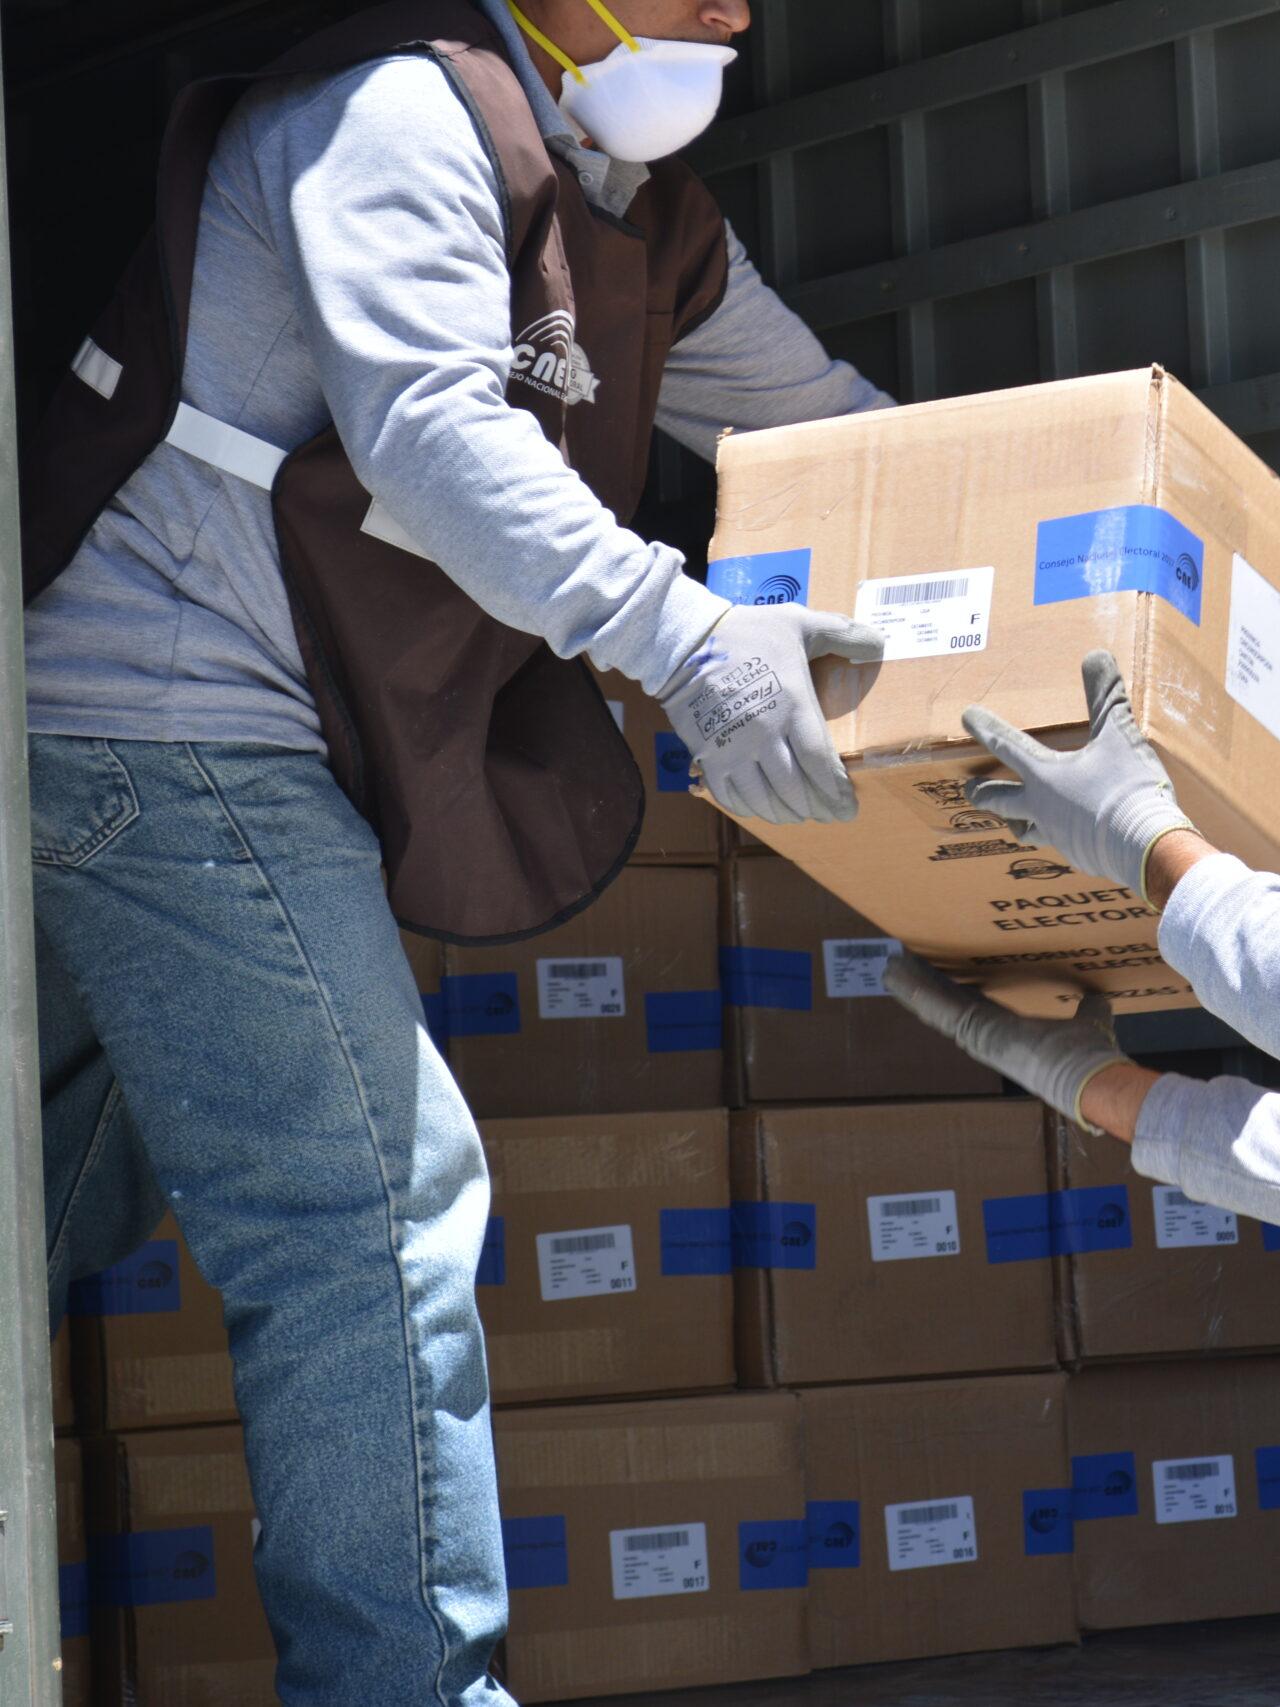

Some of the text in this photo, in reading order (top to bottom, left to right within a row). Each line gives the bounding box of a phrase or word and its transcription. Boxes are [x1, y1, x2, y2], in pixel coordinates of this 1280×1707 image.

[1039, 558, 1075, 570] Consejo
[970, 613, 980, 625] F
[950, 633, 982, 649] 0008
[734, 681, 772, 710] Flexo
[704, 708, 731, 732] Grip
[993, 905, 1160, 931] ELECTOR
[970, 948, 1101, 965] RETORNO
[610, 1278, 632, 1289] 0011
[694, 1559, 701, 1570] F
[682, 1575, 705, 1589] 0017
